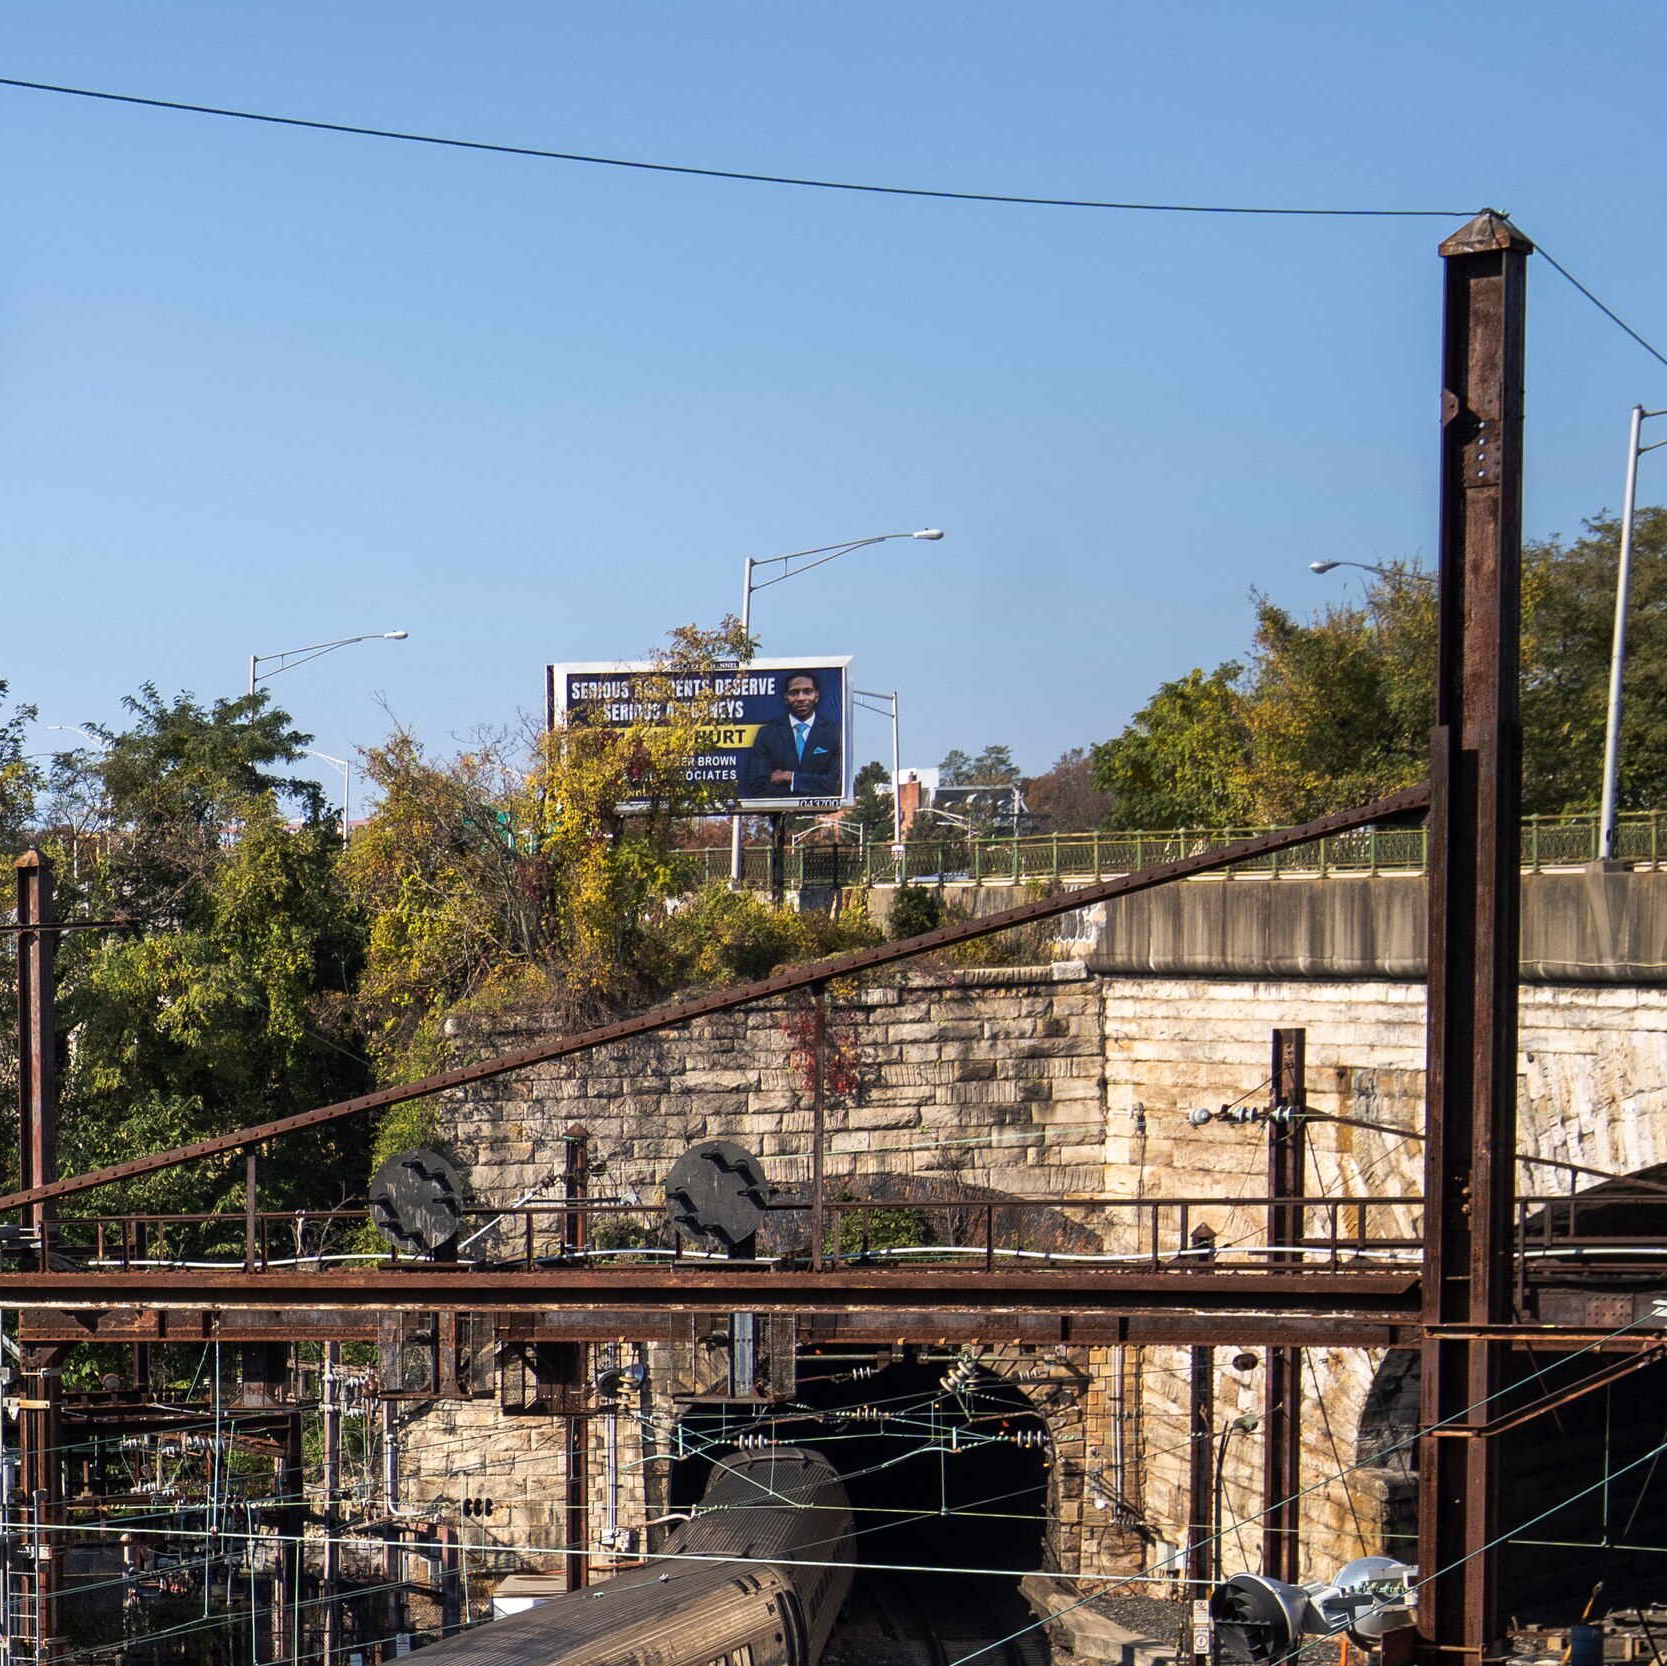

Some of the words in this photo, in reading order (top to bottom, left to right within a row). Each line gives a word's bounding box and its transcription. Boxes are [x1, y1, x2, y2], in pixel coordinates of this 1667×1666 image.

[571, 681, 629, 700] SERIOUS
[716, 677, 776, 696] DESERVE
[697, 756, 737, 767] BROWN
[679, 769, 737, 781] OCIATES
